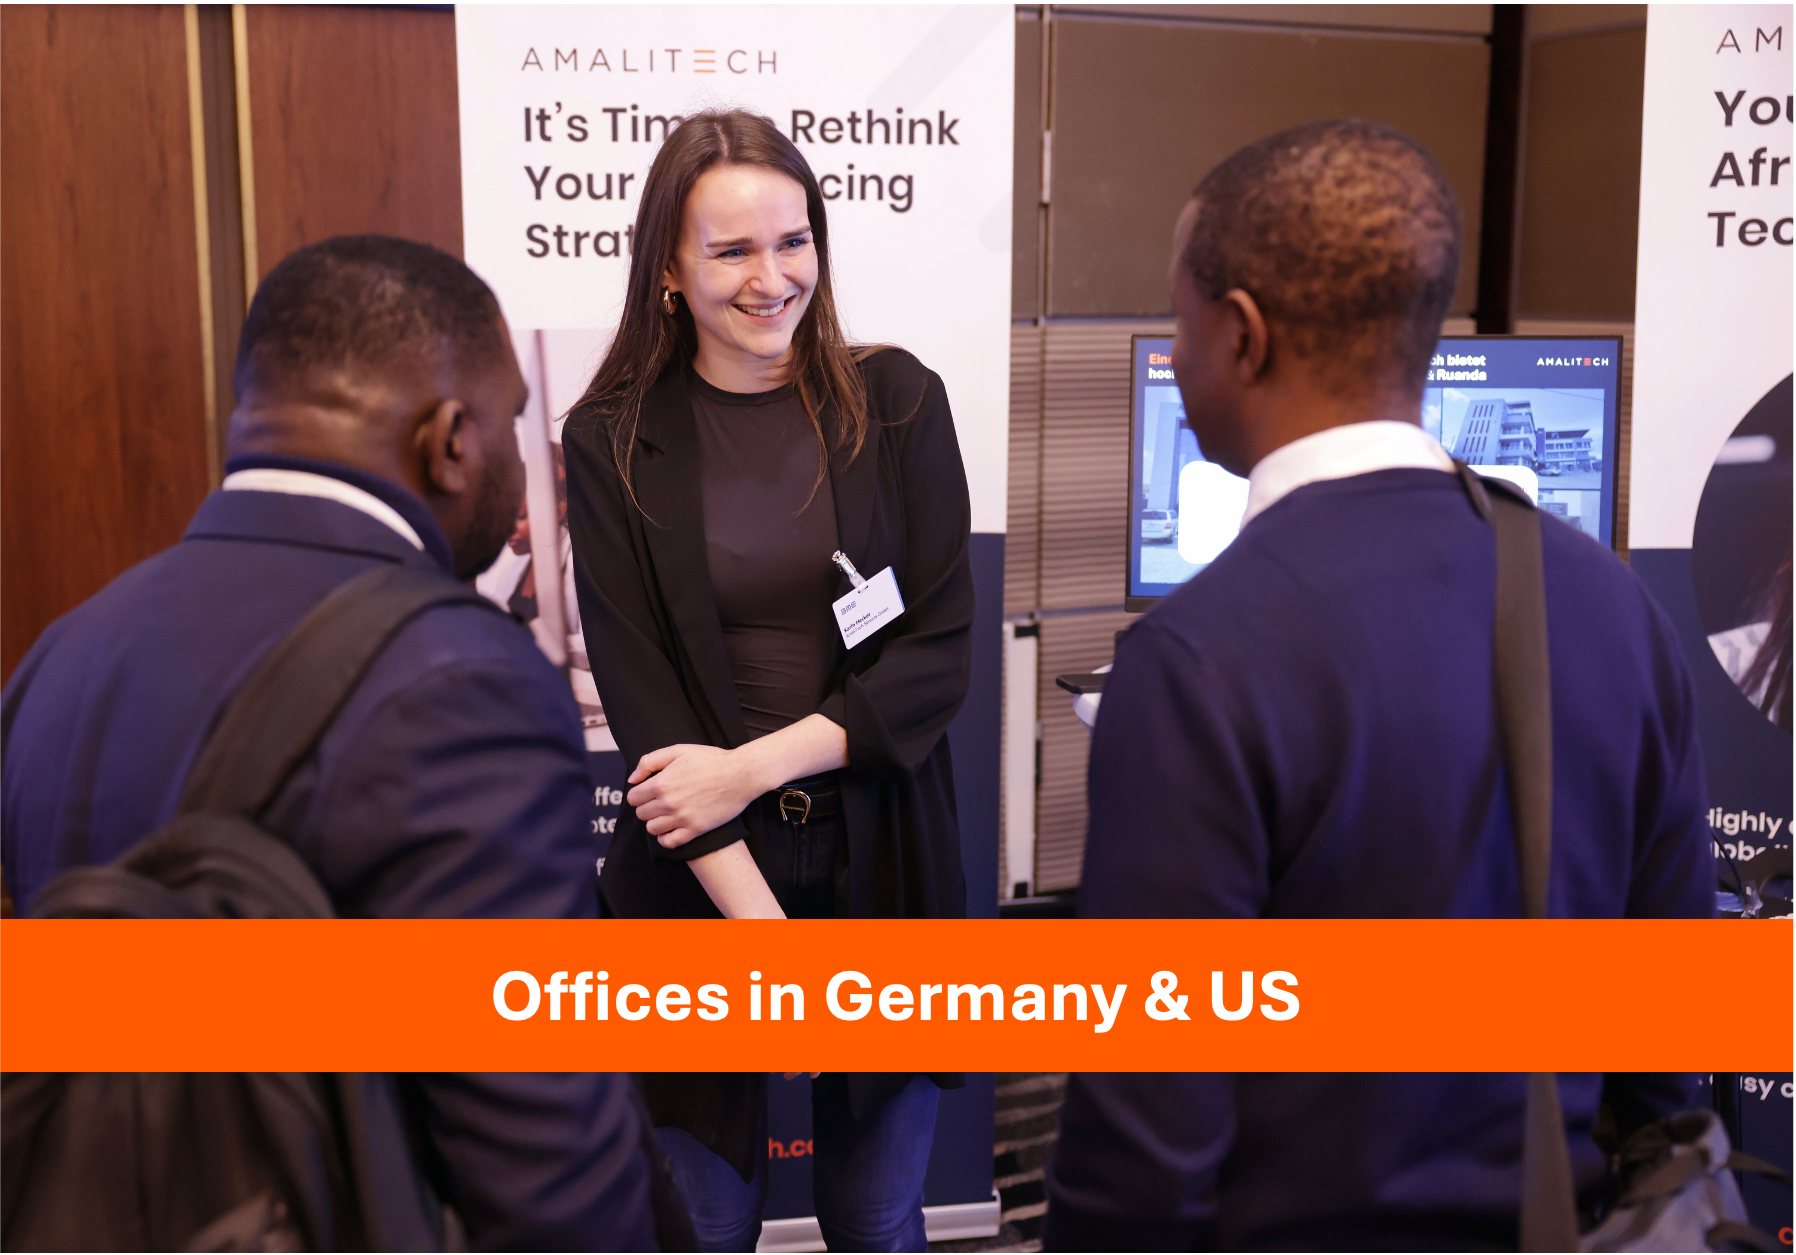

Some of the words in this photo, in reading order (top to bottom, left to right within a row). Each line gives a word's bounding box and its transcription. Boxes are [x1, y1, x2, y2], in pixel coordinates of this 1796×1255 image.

[1716, 26, 1783, 54] AM
[521, 47, 778, 75] AMALITECH
[523, 102, 589, 143] It’s
[602, 104, 685, 143] Tim
[791, 107, 960, 146] Rethink
[1713, 89, 1794, 127] Yo
[1709, 147, 1791, 188] Afr
[525, 165, 635, 201] Your
[819, 163, 914, 214] cing
[526, 223, 634, 259] Strat
[1707, 210, 1794, 248] Tec
[1430, 354, 1445, 366] ch
[1436, 368, 1488, 381] Ruanda
[1537, 357, 1609, 366] AMALITECH
